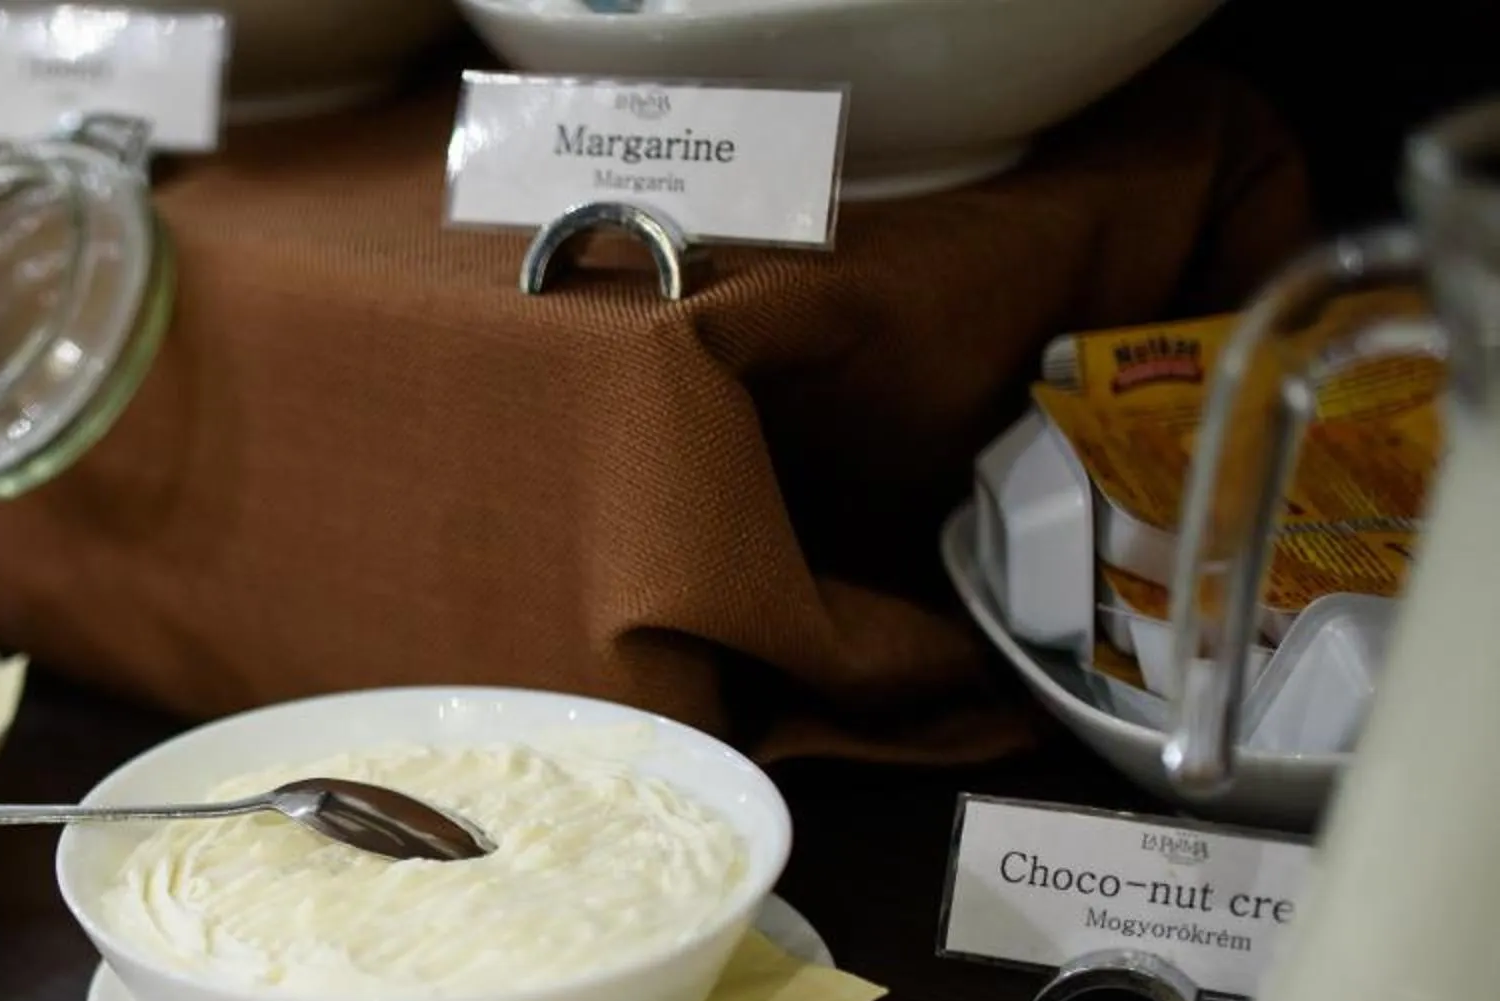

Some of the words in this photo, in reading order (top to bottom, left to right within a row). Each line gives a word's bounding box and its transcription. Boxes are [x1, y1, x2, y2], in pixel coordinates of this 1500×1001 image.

[553, 124, 736, 164] Margarine
[593, 170, 685, 194] Margarin
[999, 850, 1214, 913] Choco-nut
[1228, 896, 1296, 925] cre
[1083, 907, 1253, 952] Mogyorókrém
